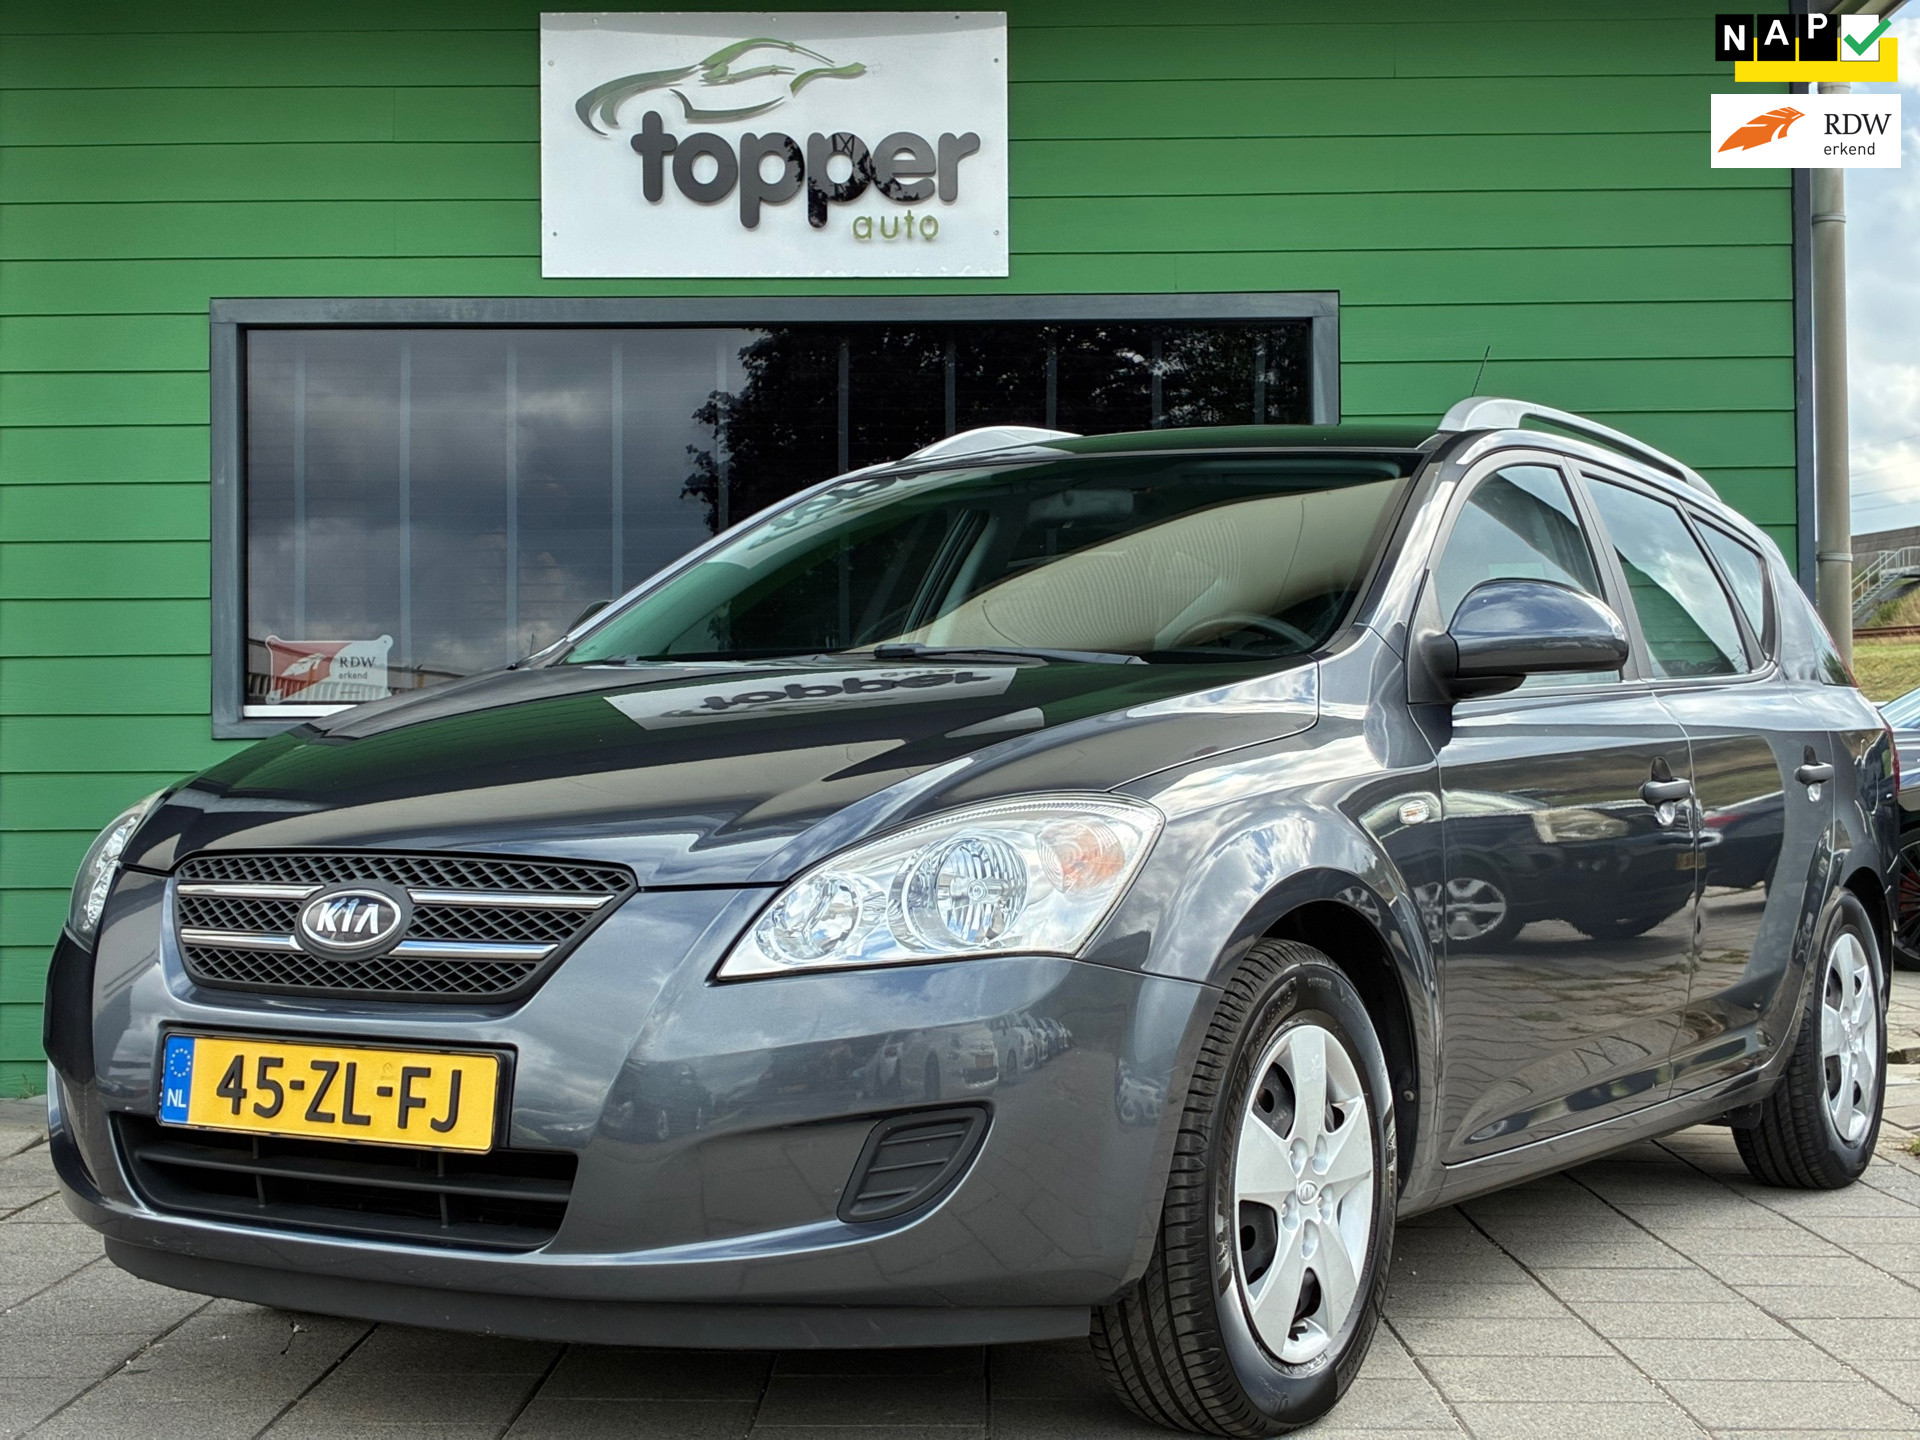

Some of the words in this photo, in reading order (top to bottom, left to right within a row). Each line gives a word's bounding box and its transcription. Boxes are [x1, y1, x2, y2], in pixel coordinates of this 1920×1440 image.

[630, 110, 981, 229] topper
[852, 209, 939, 240] auto
[338, 671, 368, 680] erkend
[339, 656, 377, 668] RDW
[316, 898, 380, 935] KIA
[167, 1088, 187, 1109] NL
[216, 1054, 463, 1133] 45-ZL-FJ
